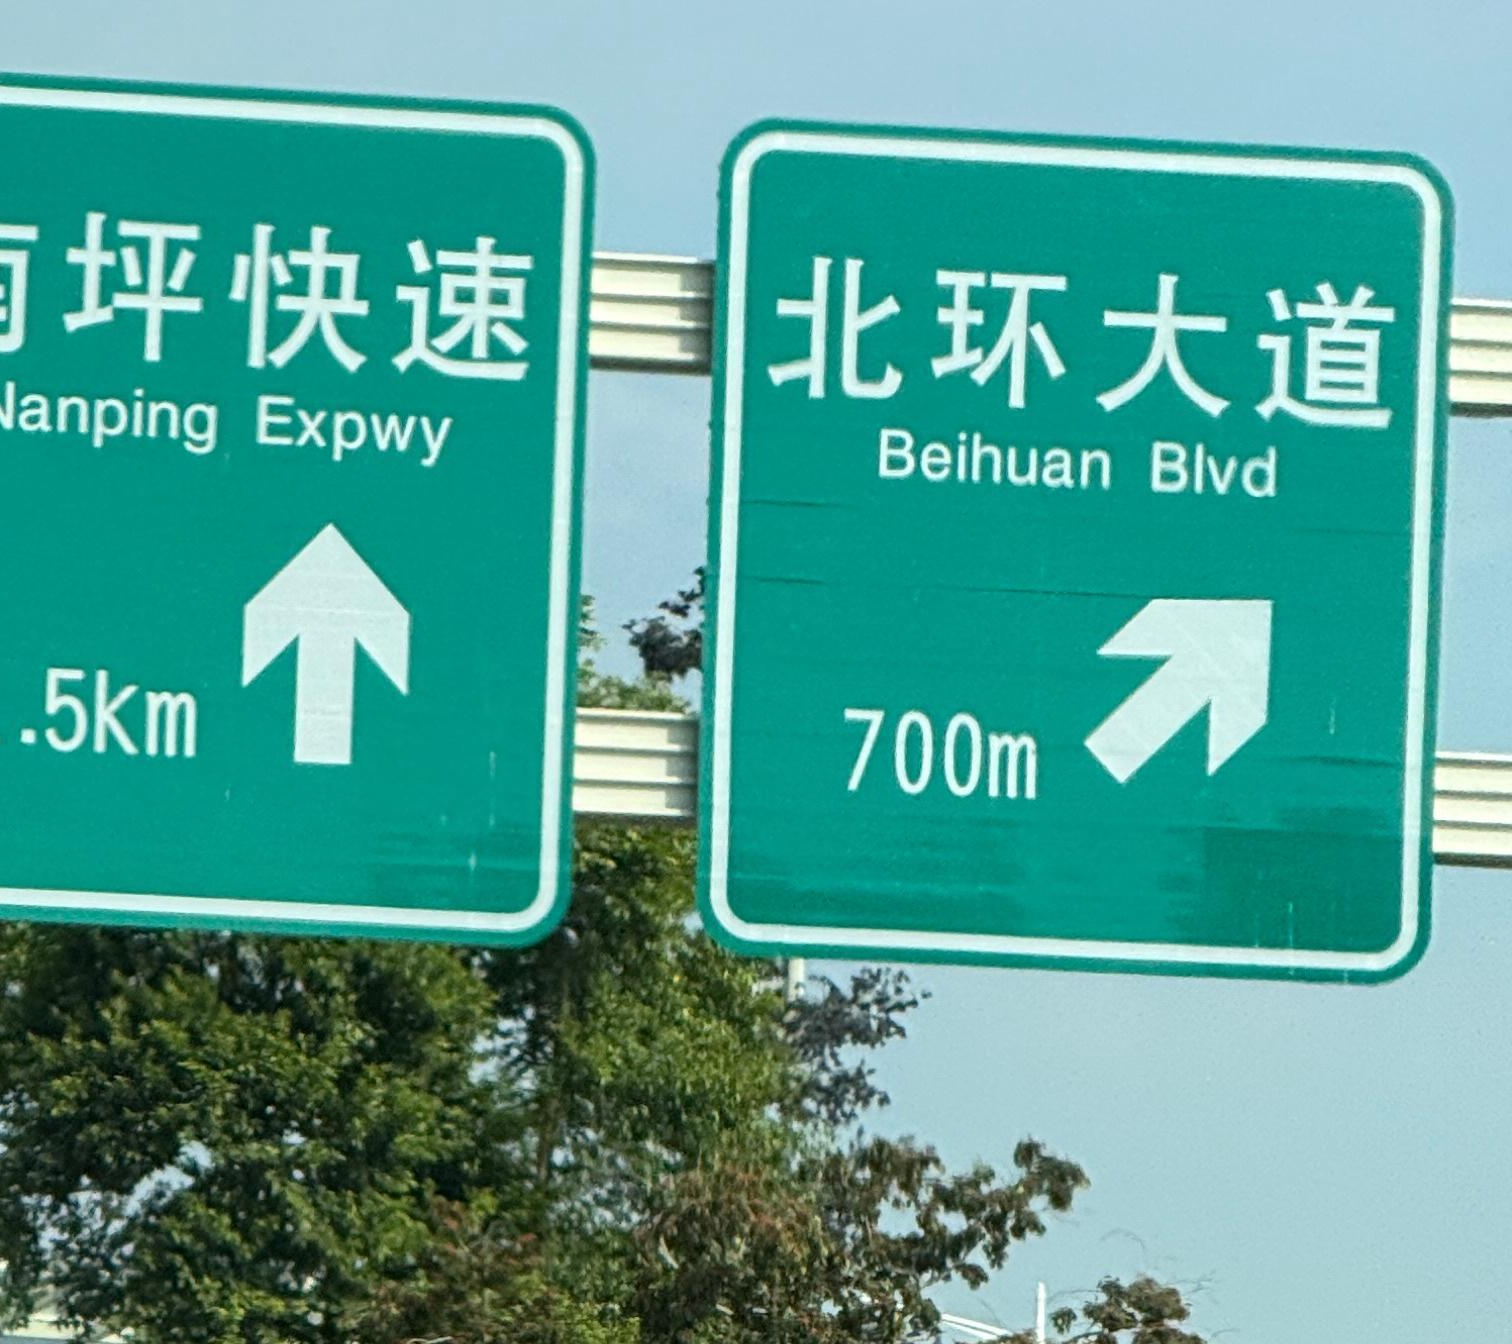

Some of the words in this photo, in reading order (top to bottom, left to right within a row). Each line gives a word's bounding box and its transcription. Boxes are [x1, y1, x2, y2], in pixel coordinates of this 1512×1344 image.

[767, 256, 1395, 430] 北环大道
[256, 394, 453, 467] Expwy
[877, 428, 1111, 489] Beihuan
[1150, 441, 1278, 498] Blvd
[843, 708, 1038, 800] 700m
